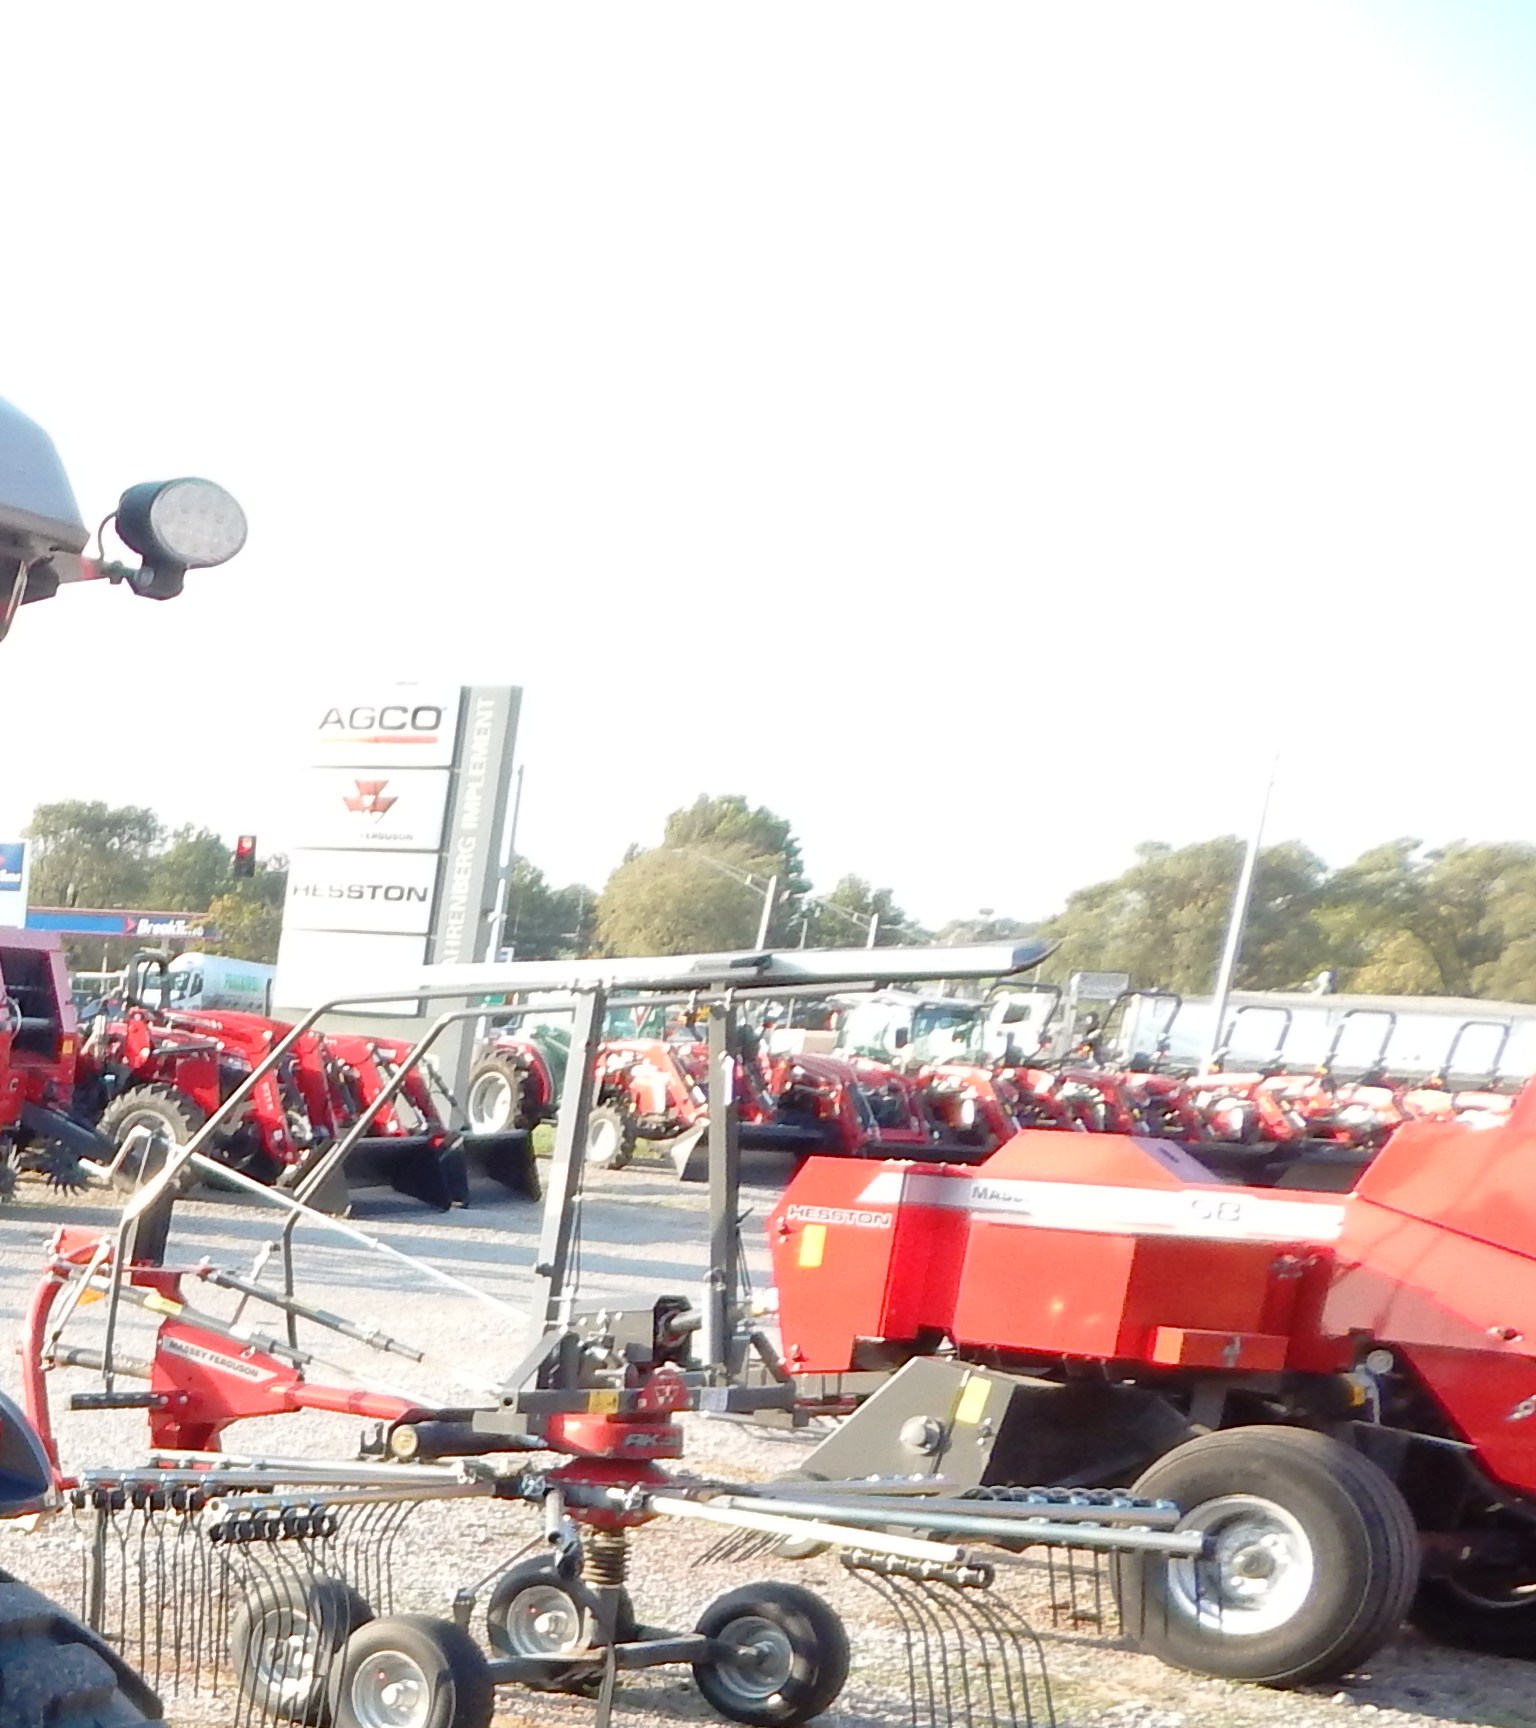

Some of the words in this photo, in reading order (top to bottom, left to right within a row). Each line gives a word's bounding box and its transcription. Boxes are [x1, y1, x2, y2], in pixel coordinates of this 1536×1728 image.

[318, 705, 443, 731] AGCO
[361, 832, 414, 841] ERGUSON
[442, 836, 477, 966] AHRENBERG
[461, 697, 495, 830] IMPLEMENT
[292, 884, 429, 902] HESSTON
[788, 1204, 892, 1227] HESSTON
[169, 1341, 207, 1359] MASSEY
[209, 1353, 259, 1377] FERGUSON
